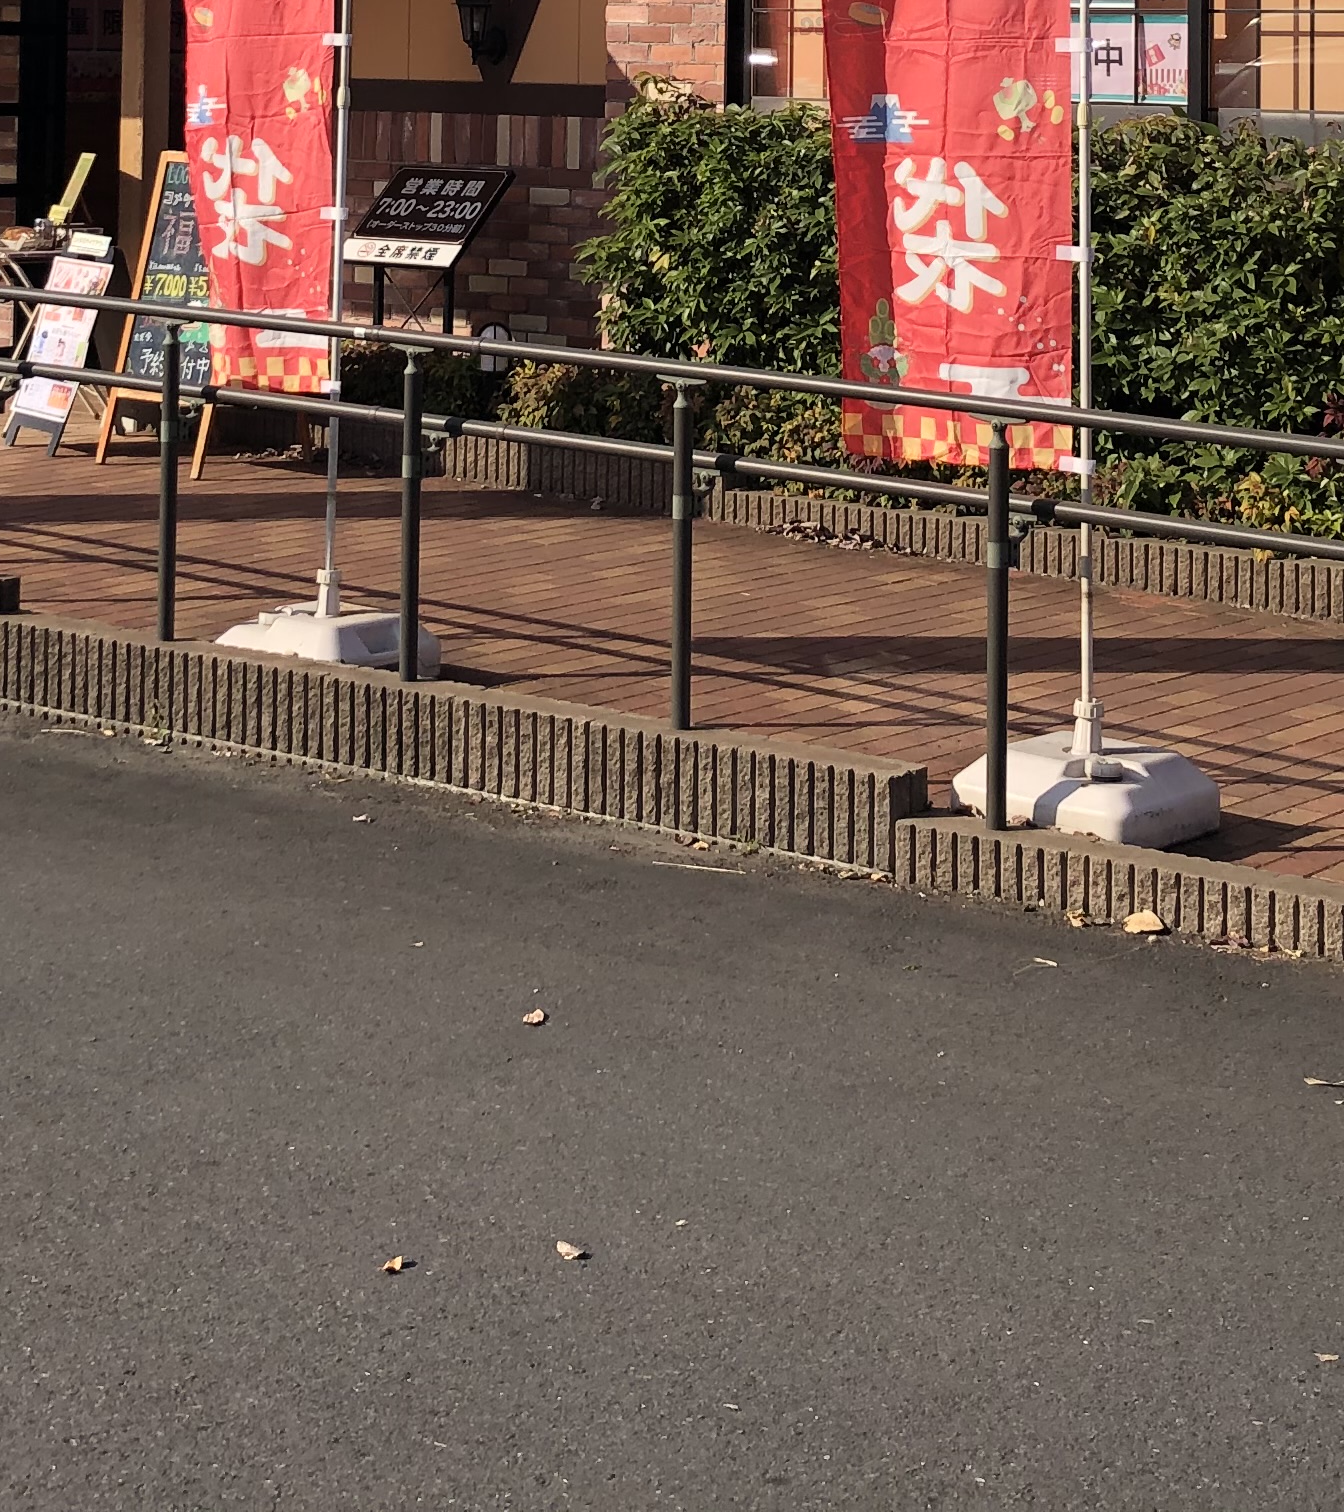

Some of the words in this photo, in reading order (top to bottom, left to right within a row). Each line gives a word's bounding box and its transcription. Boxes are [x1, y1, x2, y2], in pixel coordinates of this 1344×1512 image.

[401, 177, 485, 198] 営業時間
[374, 244, 440, 261] 全席禁煙
